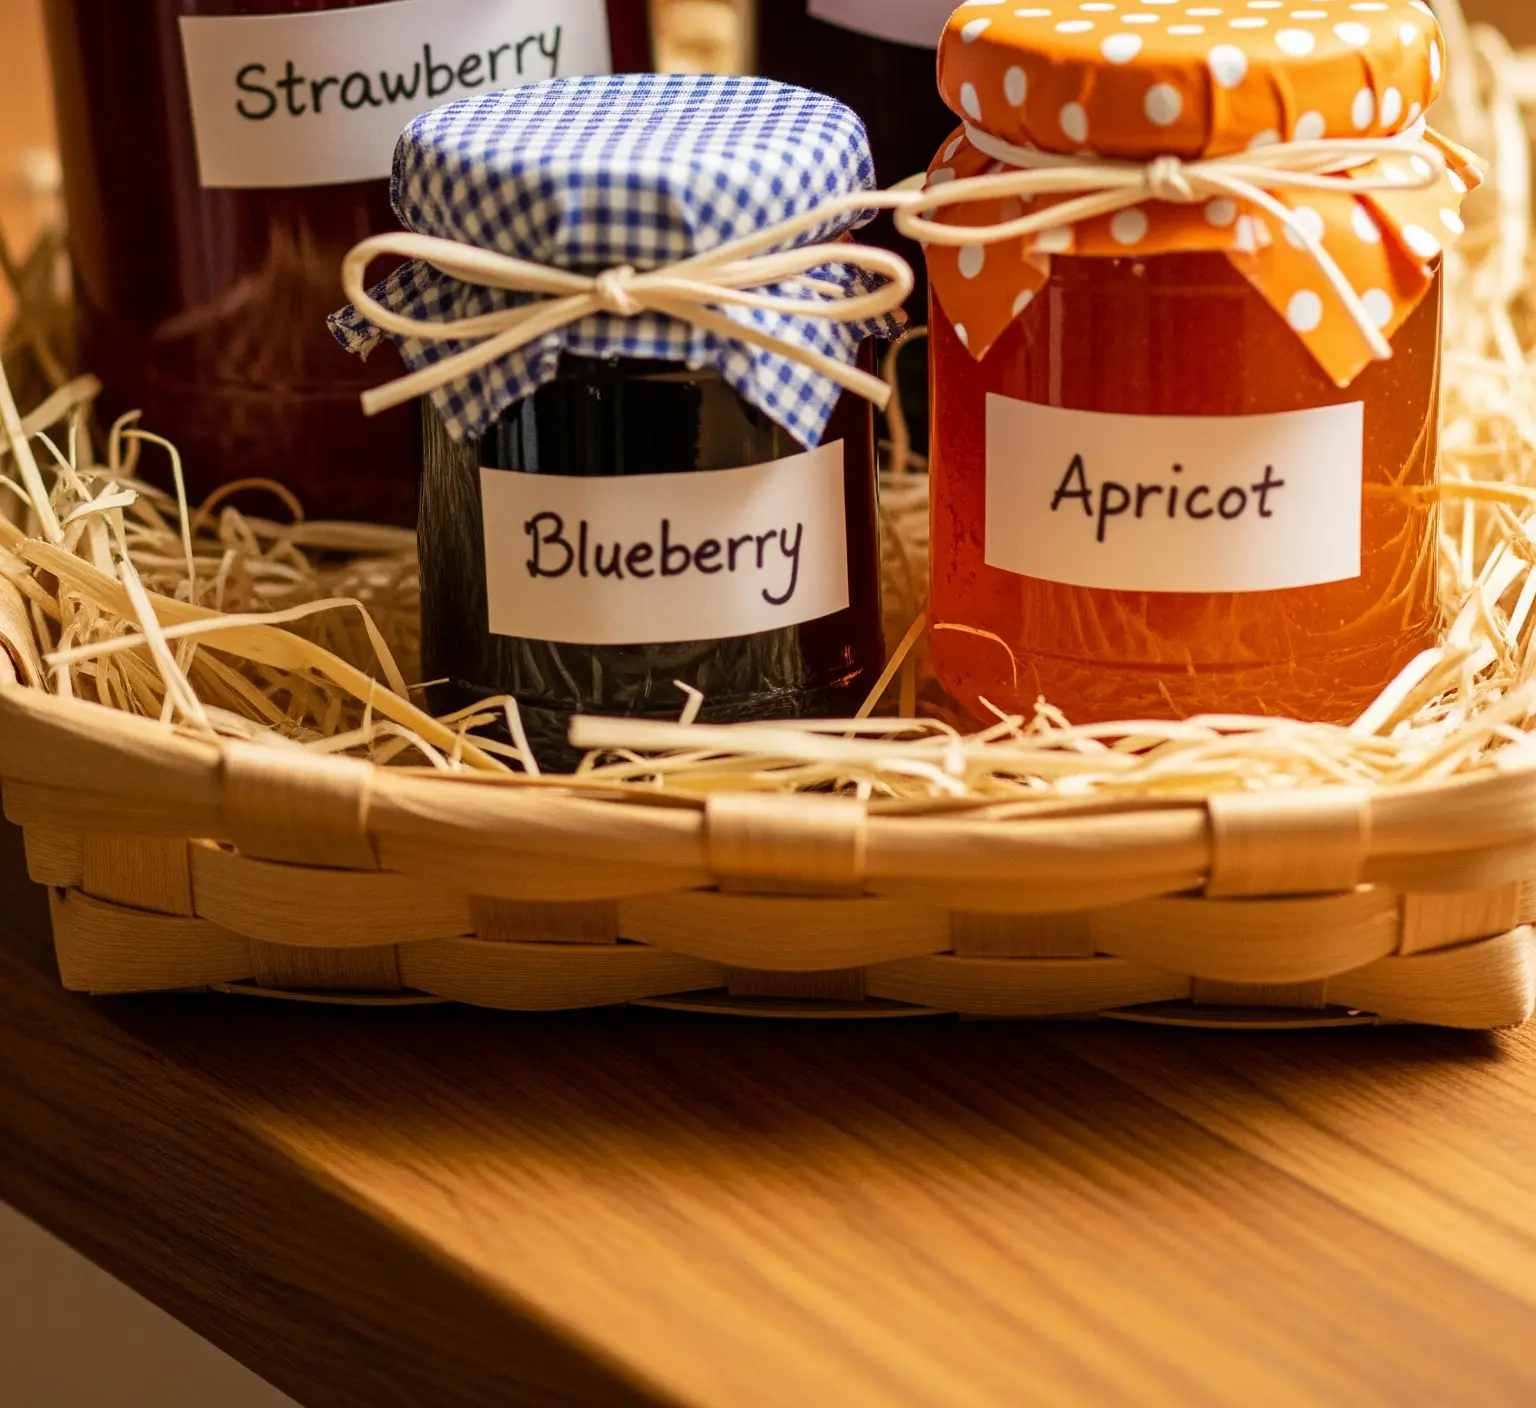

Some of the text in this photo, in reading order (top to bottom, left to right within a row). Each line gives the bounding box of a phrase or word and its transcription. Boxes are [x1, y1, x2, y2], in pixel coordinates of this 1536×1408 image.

[235, 24, 561, 120] Strawberry
[1050, 453, 1285, 543] Apricot
[524, 511, 803, 605] Blueberry
